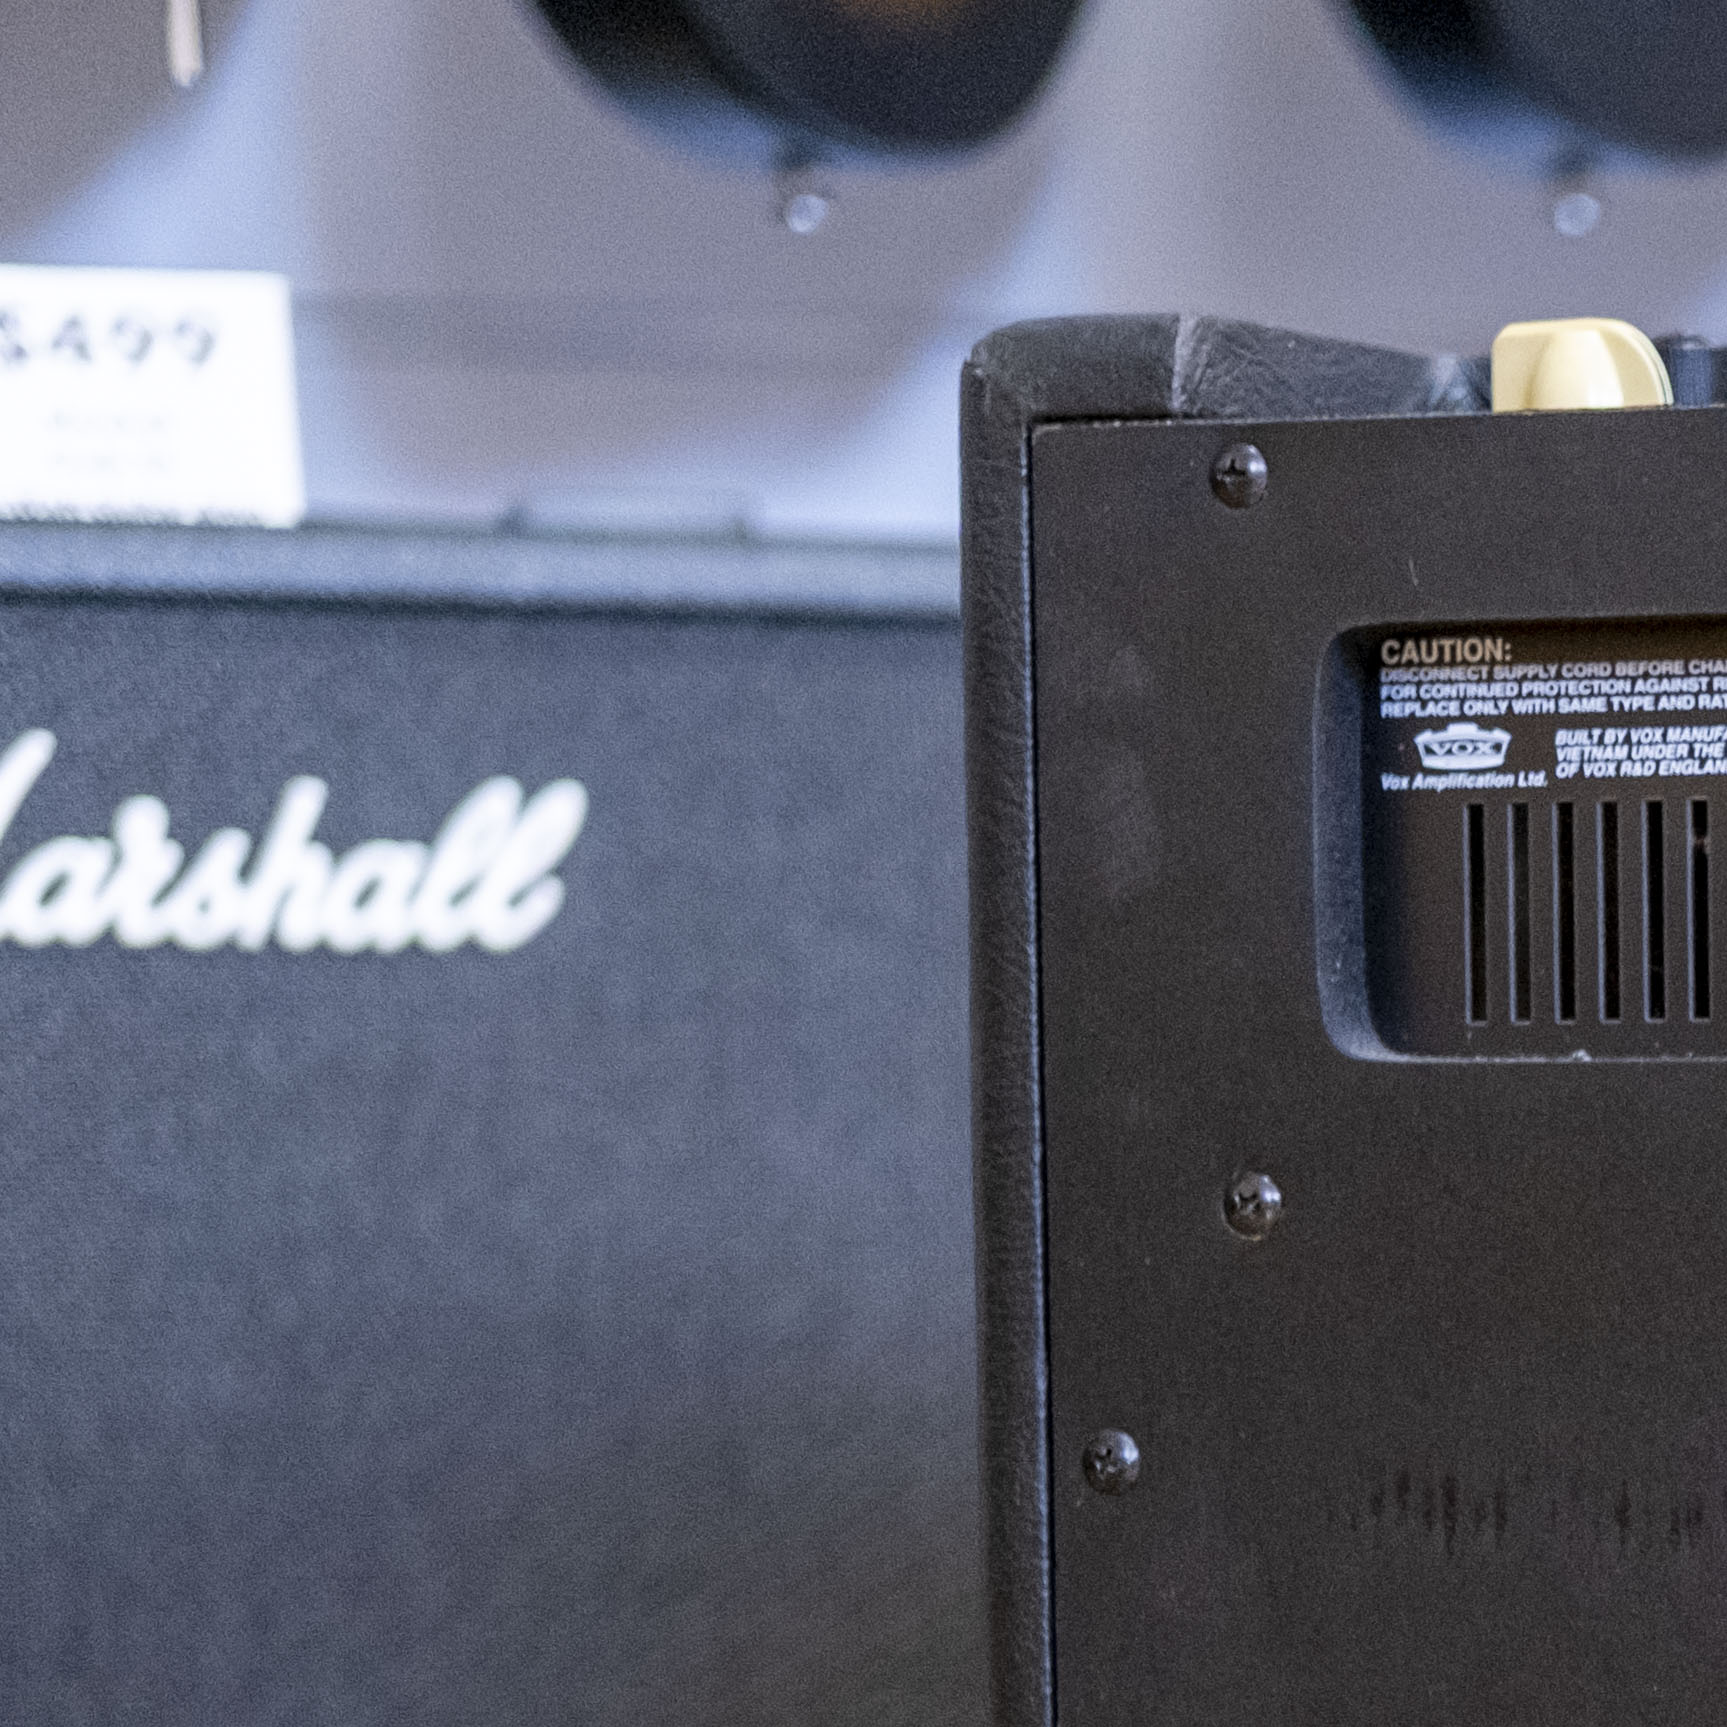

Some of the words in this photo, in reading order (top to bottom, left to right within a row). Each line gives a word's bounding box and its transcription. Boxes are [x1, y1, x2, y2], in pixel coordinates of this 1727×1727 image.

[1381, 637, 1512, 665] CAUTION:
[1379, 665, 1489, 683] DISCONNECT
[1493, 663, 1558, 682] SUPPLY
[1560, 661, 1612, 679] CORD
[1614, 659, 1685, 677] BEFORE
[1380, 683, 1417, 701] FOR
[1419, 680, 1519, 700] CONTINUED
[1521, 678, 1632, 697] PROTECTION
[1633, 675, 1710, 694] AGAINST
[1380, 701, 1461, 719] REPLACE
[1463, 699, 1508, 717] ONLY
[1511, 697, 1556, 715] WITH
[1557, 695, 1608, 713] SAME
[1611, 694, 1656, 712] TYPE
[1657, 692, 1696, 710] AND
[1555, 728, 1602, 746] BUILT
[1604, 726, 1628, 744] BY
[1630, 726, 1664, 744] VOX
[1425, 741, 1493, 757] VOX
[1555, 744, 1629, 763] VIETNAM
[1630, 742, 1690, 761] UNDER
[1691, 740, 1726, 758] THE
[1381, 773, 1411, 791] Vox
[1411, 770, 1516, 794] Amplification
[1517, 768, 1548, 789] Ltd.
[1555, 762, 1581, 779] OF
[1583, 760, 1617, 778] VOX
